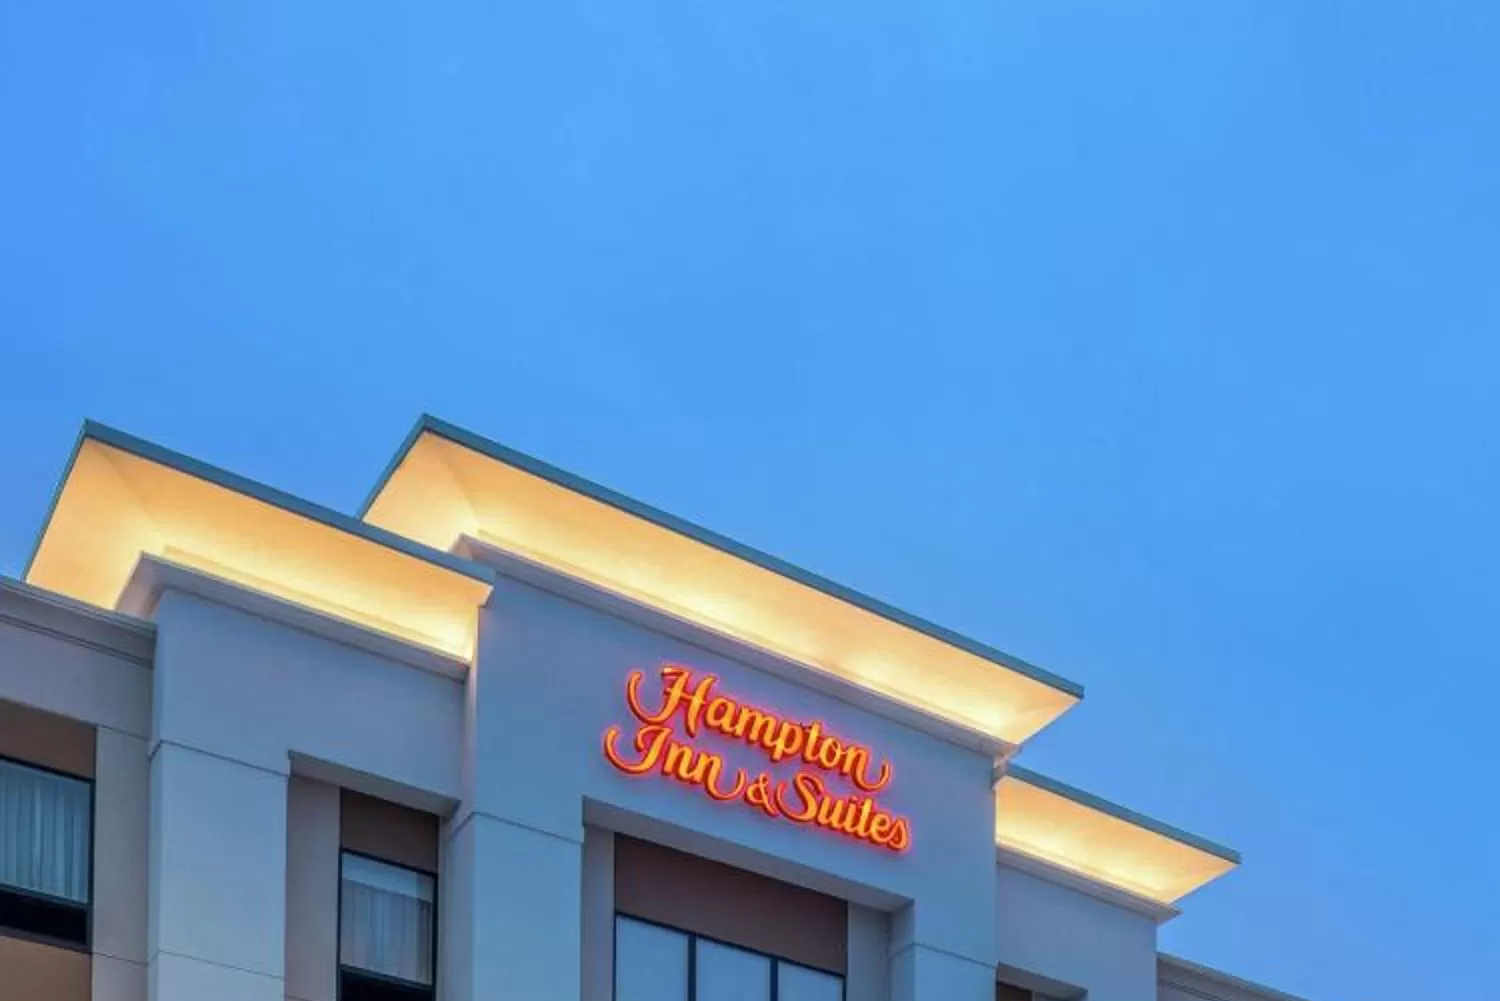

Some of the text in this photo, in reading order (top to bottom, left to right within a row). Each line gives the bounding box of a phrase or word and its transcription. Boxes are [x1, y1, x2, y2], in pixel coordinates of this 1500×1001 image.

[604, 724, 911, 851] Inn & Suites
[628, 665, 891, 791] Hampton
